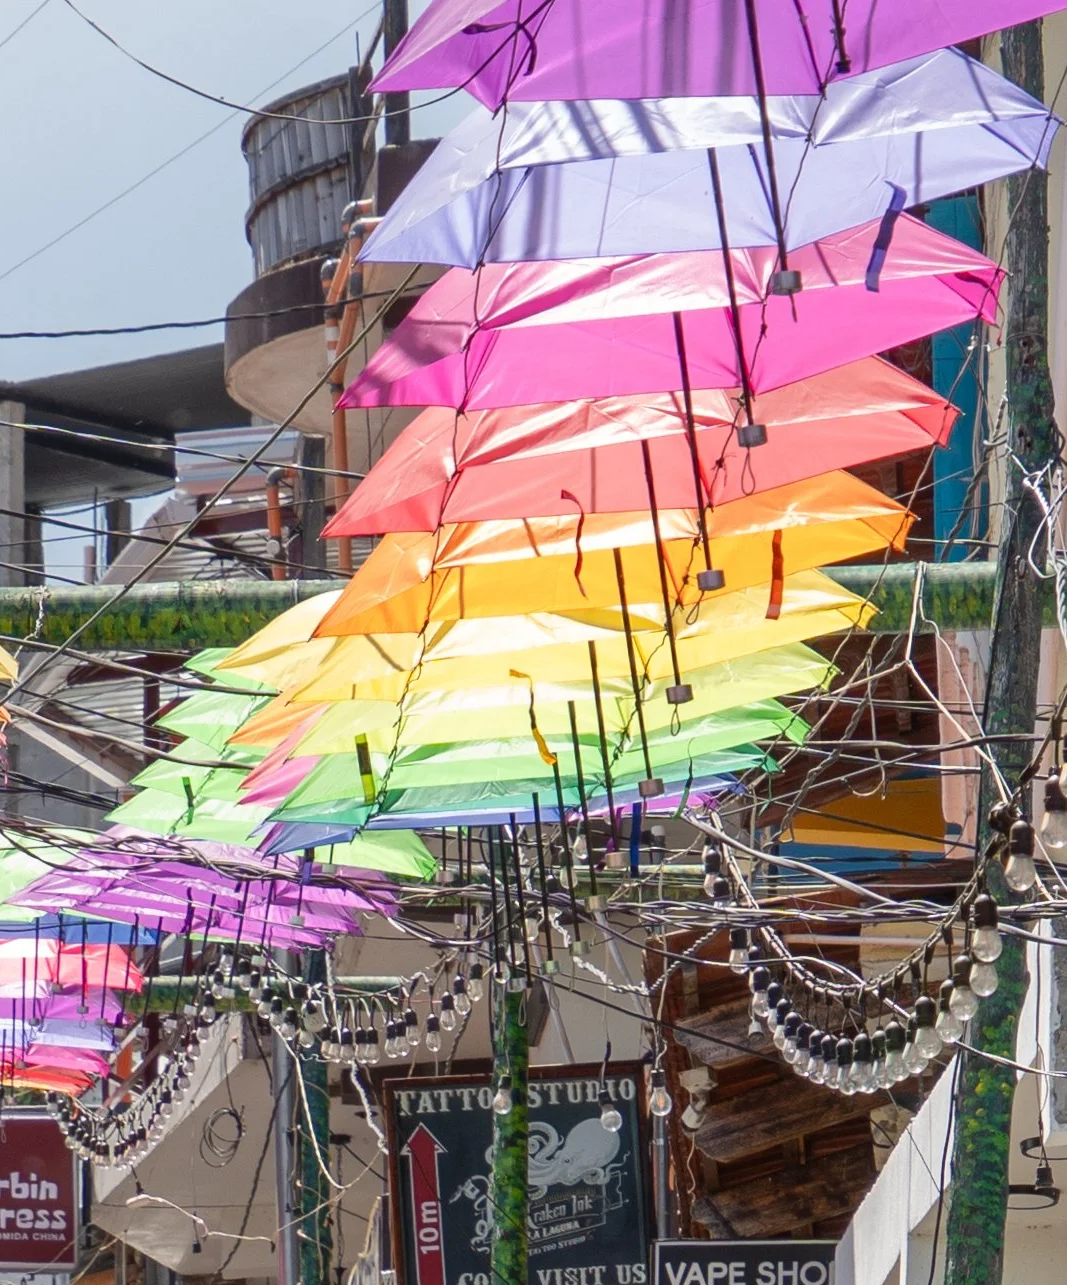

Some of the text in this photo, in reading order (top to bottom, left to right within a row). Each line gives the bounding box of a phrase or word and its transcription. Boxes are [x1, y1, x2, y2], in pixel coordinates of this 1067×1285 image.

[394, 1078, 636, 1116] TATTO STUDIO
[32, 1232, 66, 1241] CHINA
[542, 1220, 581, 1237] LAGUNA
[615, 1263, 647, 1285] US
